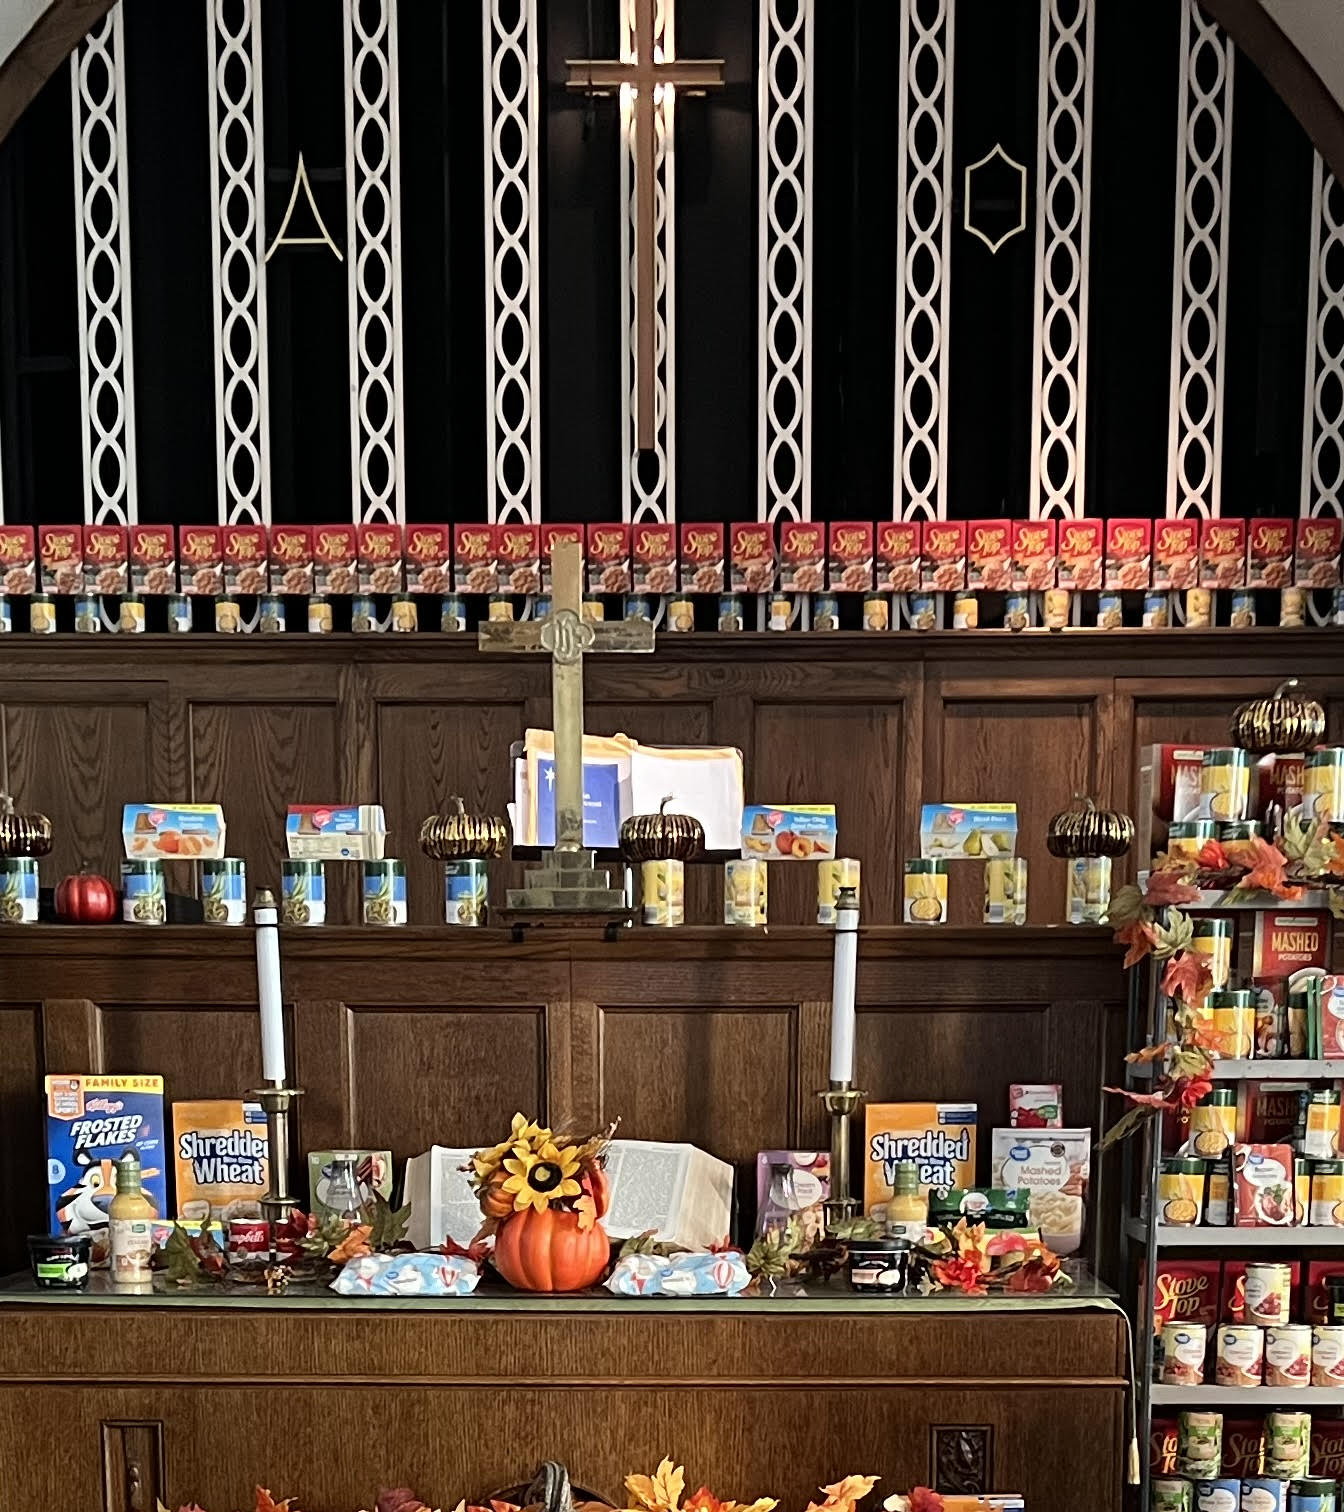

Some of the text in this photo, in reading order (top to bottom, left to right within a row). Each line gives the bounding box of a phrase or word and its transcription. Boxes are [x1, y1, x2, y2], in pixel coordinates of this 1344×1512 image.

[1272, 932, 1318, 953] MASHED
[85, 1078, 159, 1088] FAMILY SIZE
[70, 1115, 143, 1136] FROSTED
[75, 1129, 136, 1150] FLAKES
[180, 1130, 269, 1158] Shredde
[871, 1128, 970, 1162] Shredded
[194, 1158, 264, 1184] Wheat
[1021, 1164, 1062, 1175] Mashed
[1017, 1175, 1061, 1186] Potatoes
